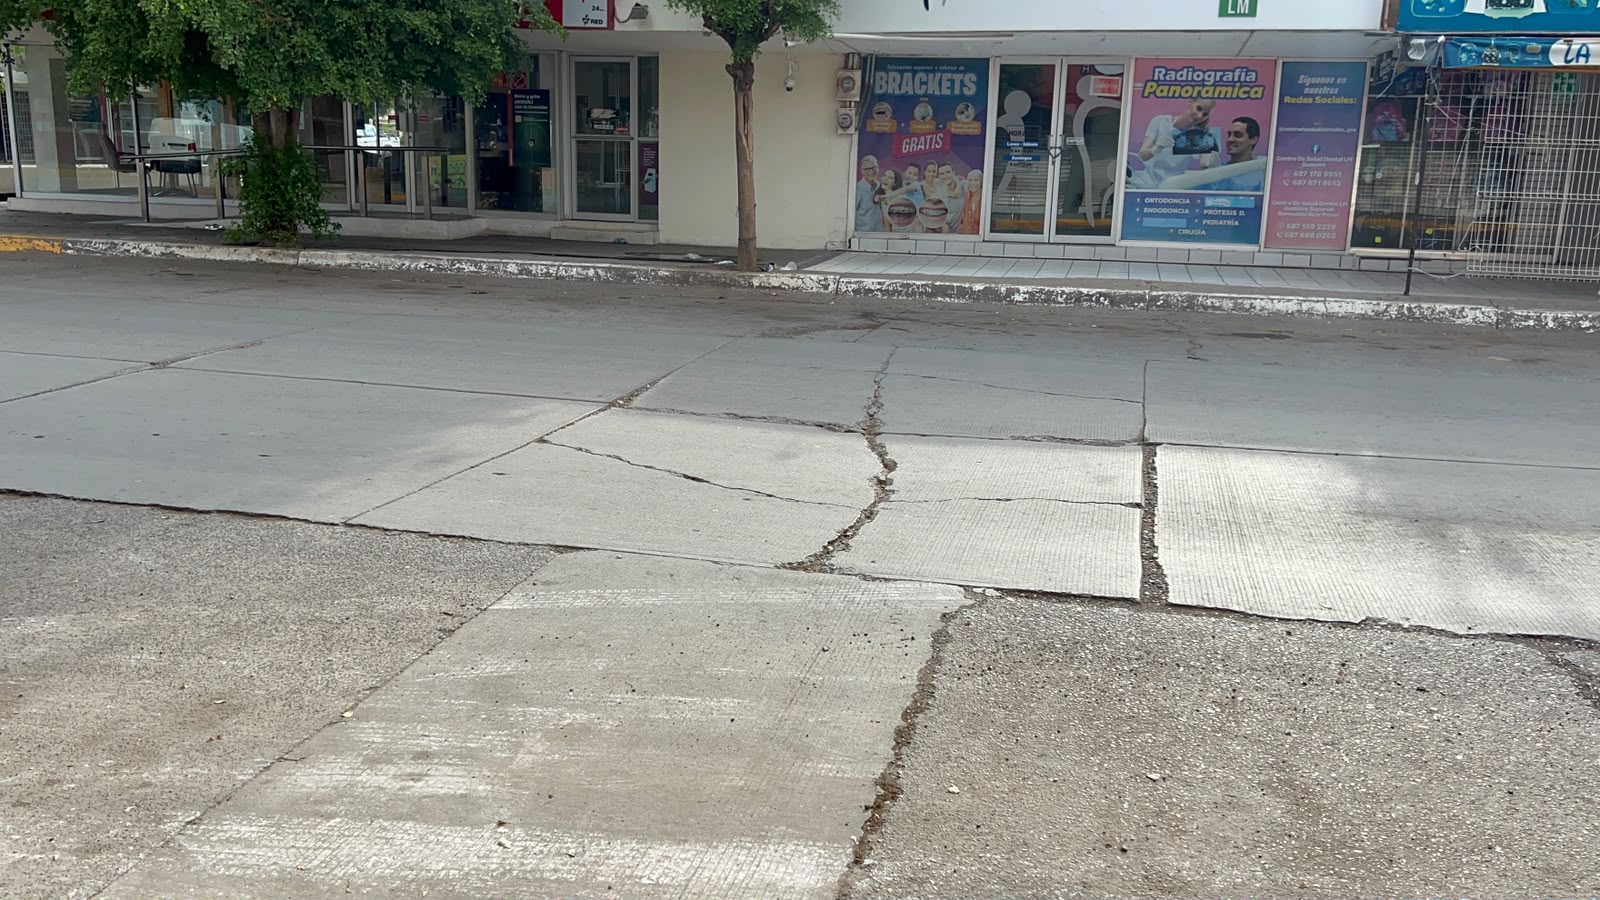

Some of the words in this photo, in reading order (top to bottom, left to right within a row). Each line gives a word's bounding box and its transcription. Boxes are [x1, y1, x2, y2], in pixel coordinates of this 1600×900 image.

[1227, 0, 1250, 14] LM
[875, 72, 977, 96] BRACKETS
[902, 133, 944, 153] GRATIS
[1204, 208, 1237, 216] PRÓTESIS
